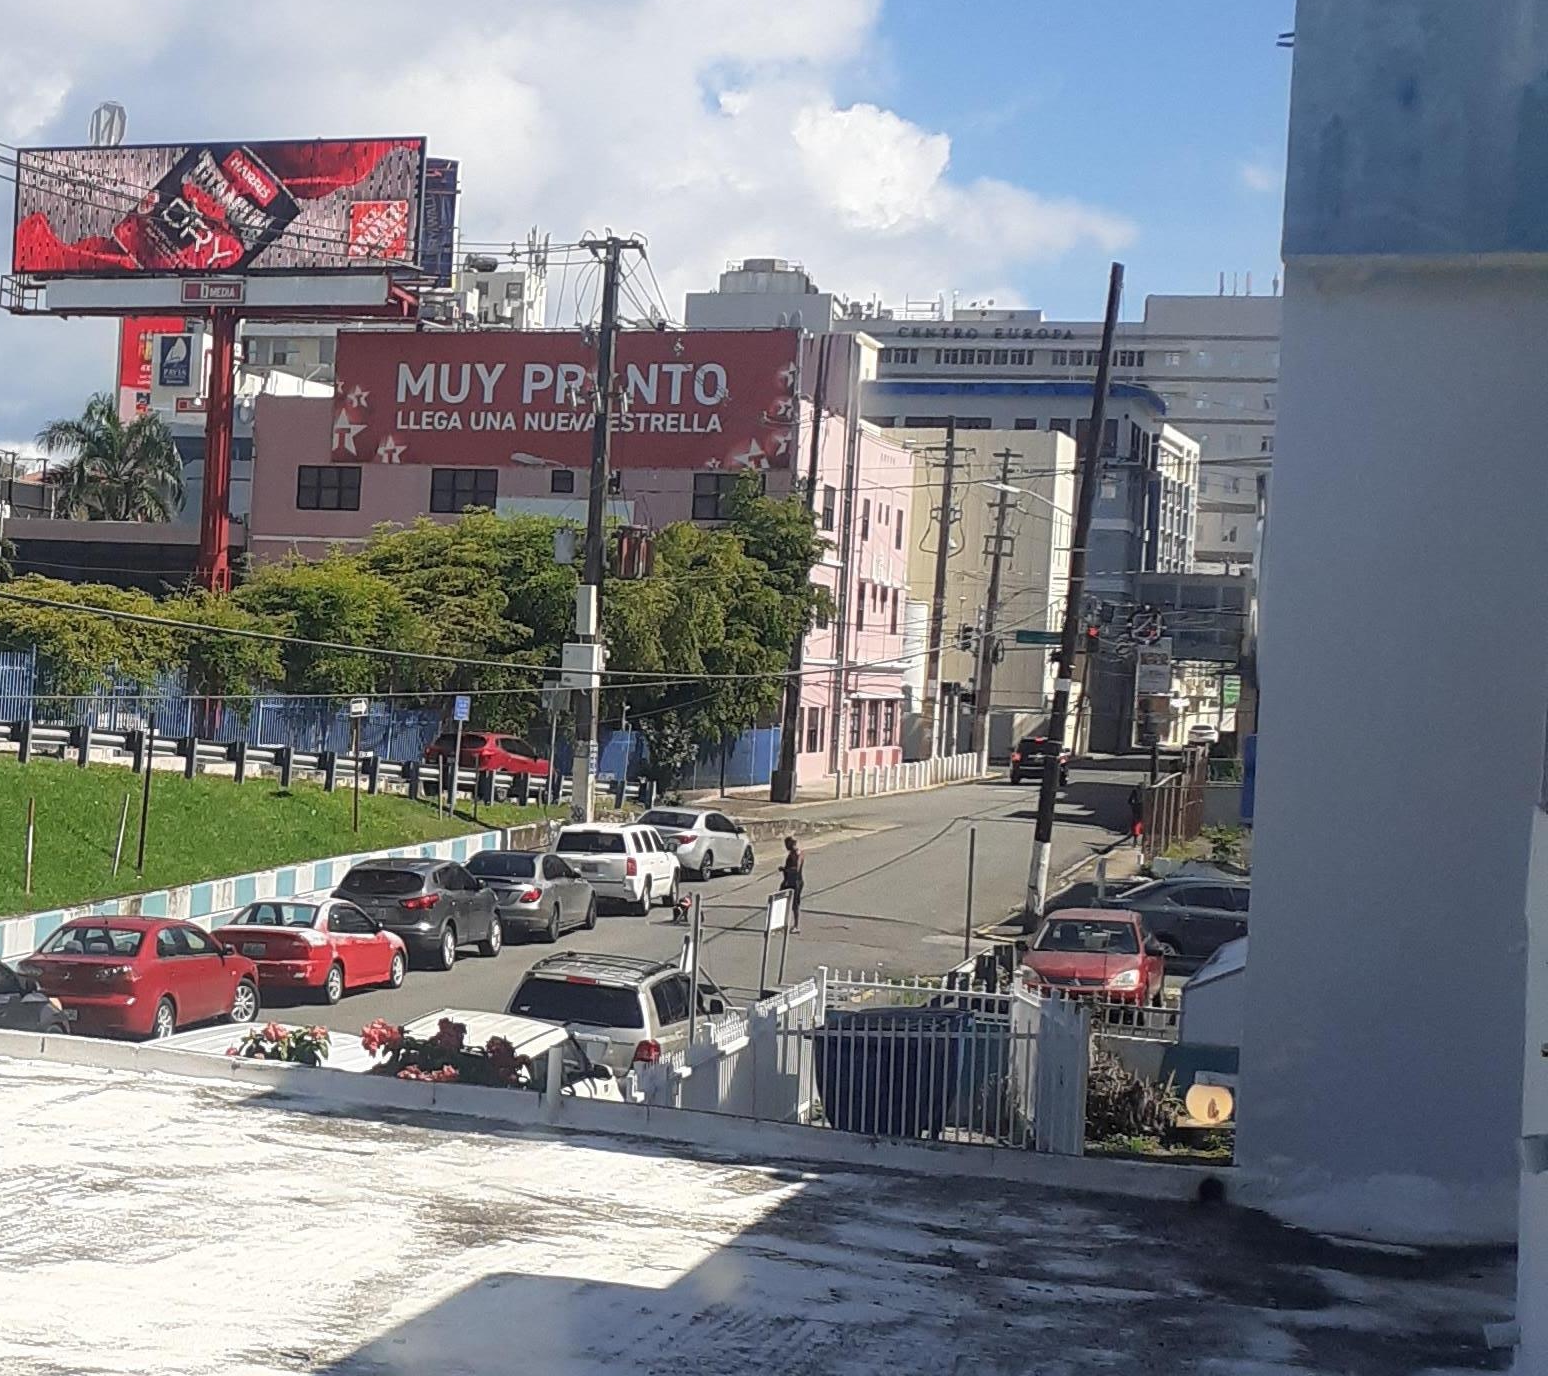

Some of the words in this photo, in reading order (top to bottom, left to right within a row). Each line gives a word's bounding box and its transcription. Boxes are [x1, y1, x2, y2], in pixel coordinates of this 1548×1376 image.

[231, 157, 271, 199] HARRIS
[161, 197, 234, 265] DRY
[898, 326, 979, 340] CENTRO
[994, 327, 1075, 340] EUROPA
[396, 363, 507, 404] MUY
[521, 363, 728, 406] PRNTO
[396, 411, 463, 431] LLEGA
[470, 412, 517, 432] UNA
[524, 411, 598, 433] NUEVA
[607, 412, 723, 434] ESTRELLA
